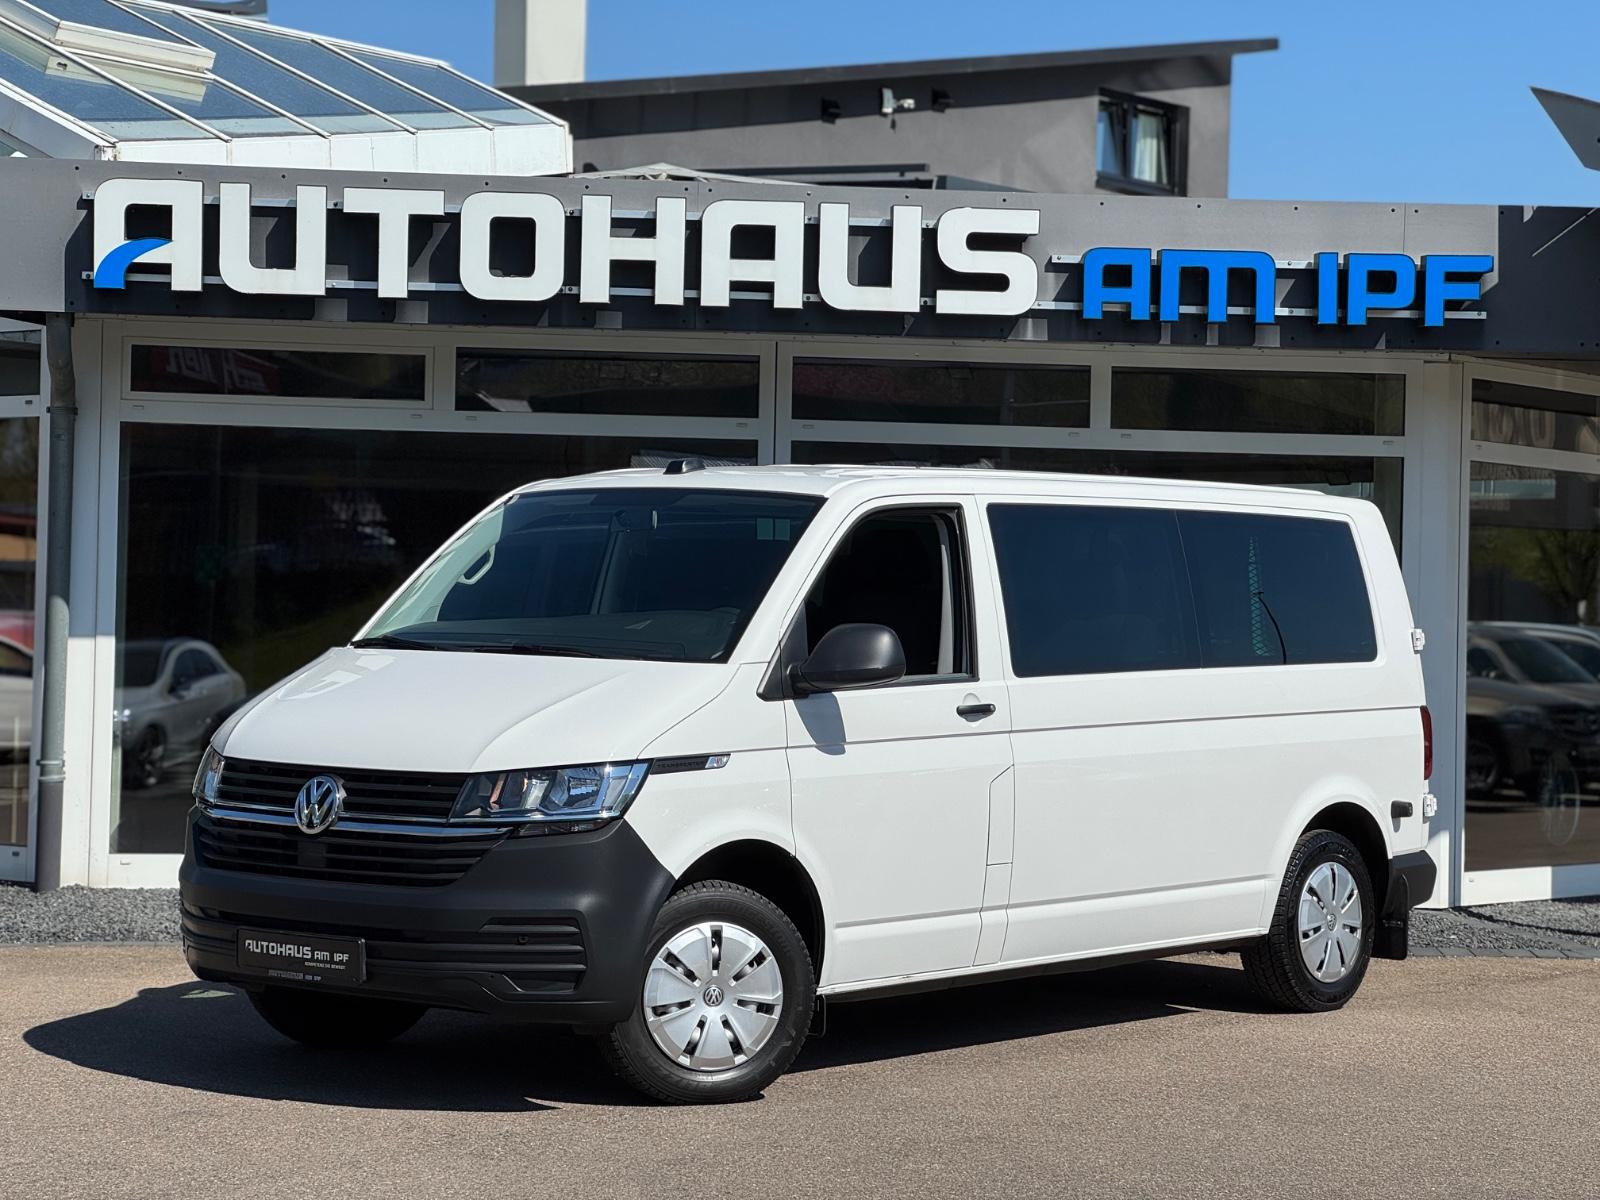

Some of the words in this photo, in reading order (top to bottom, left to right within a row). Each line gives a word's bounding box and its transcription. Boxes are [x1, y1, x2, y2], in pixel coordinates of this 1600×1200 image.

[93, 178, 1041, 316] AUTOHAUS
[1082, 247, 1277, 323] AM
[1316, 251, 1494, 327] IPF
[295, 776, 339, 834] VW
[245, 939, 312, 959] AUTOHAUS
[314, 951, 330, 961] AM
[334, 953, 349, 963] IPF
